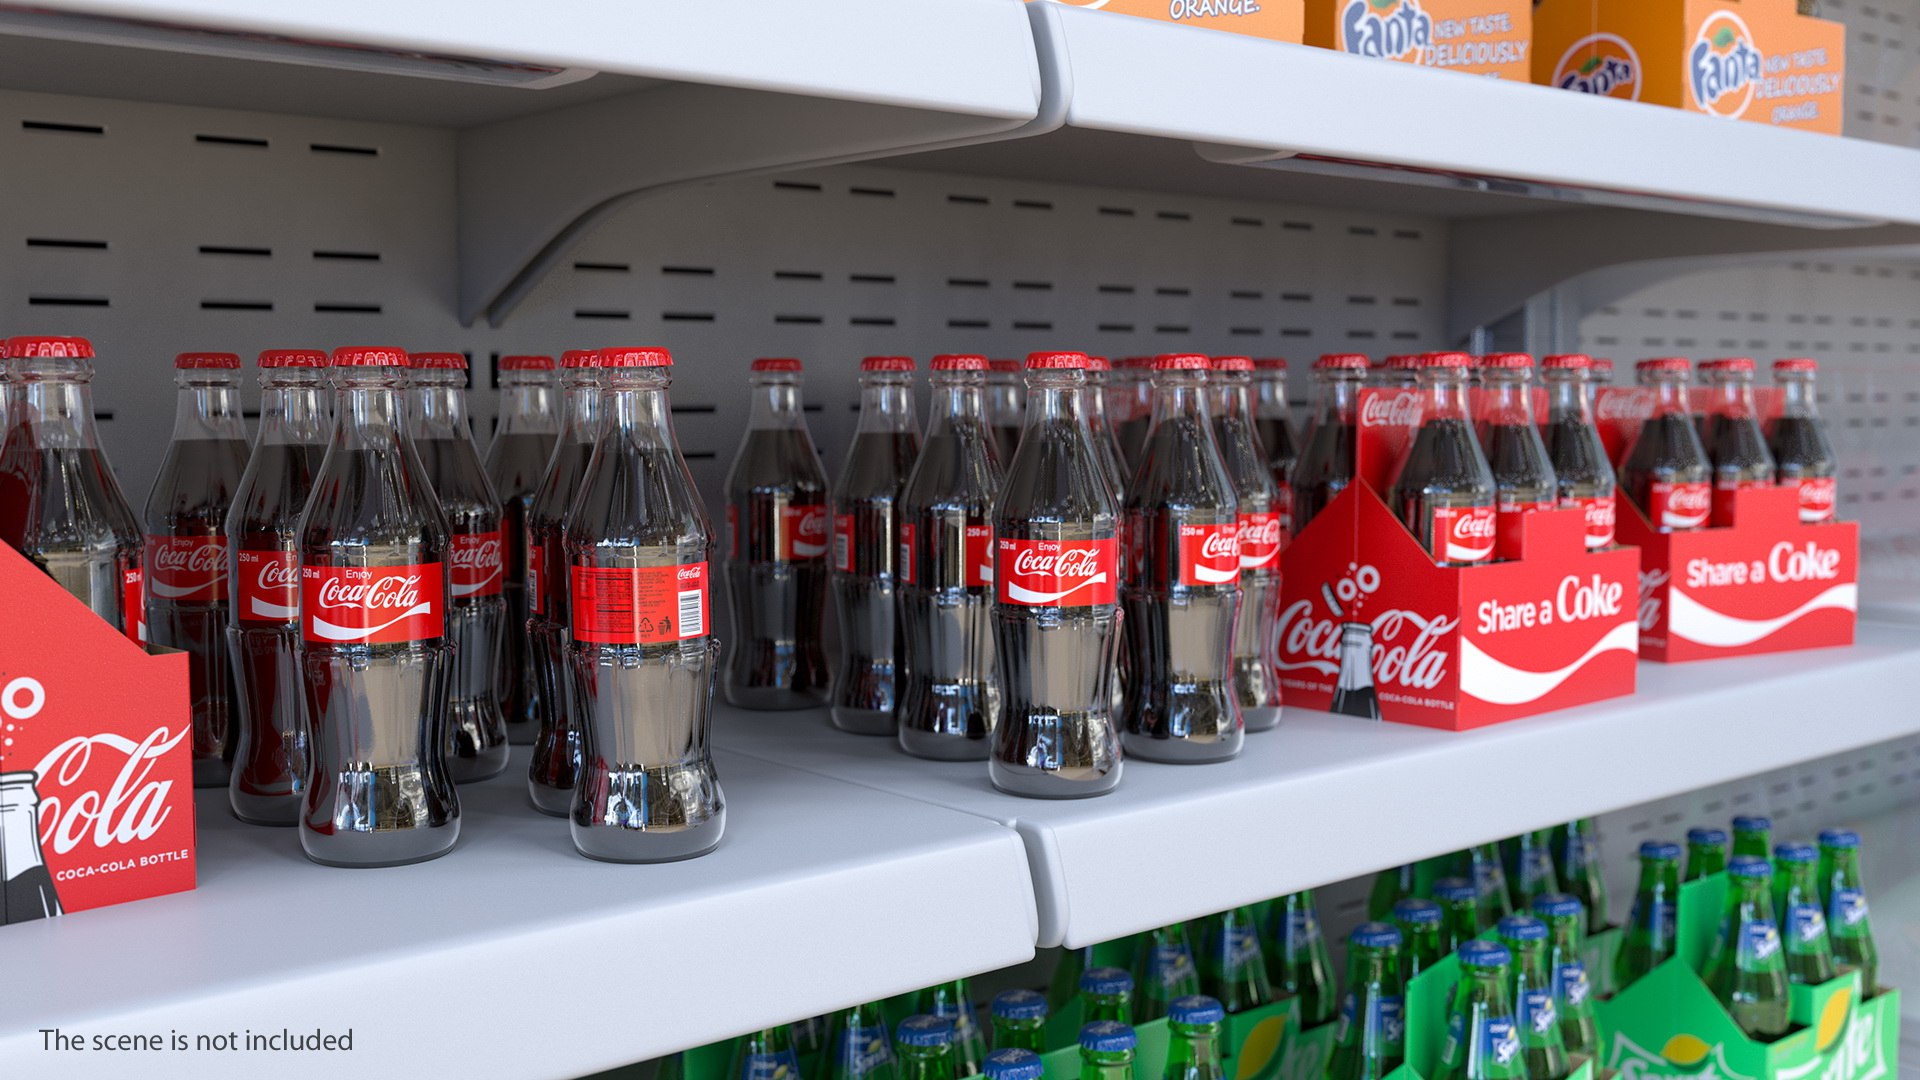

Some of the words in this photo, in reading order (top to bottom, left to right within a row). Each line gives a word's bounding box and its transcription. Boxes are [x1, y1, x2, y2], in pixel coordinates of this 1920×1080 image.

[1434, 20, 1466, 39] NEW
[1469, 13, 1513, 34] TASTE
[1423, 41, 1529, 67] DELICIOUSLY
[1690, 36, 1763, 110] Fanta
[1038, 542, 1061, 552] Enjoy
[303, 567, 313, 578] 250
[345, 569, 373, 579] Enjoy
[1014, 548, 1101, 577] Coca-Cola
[1687, 558, 1747, 588] Share
[1750, 561, 1765, 584] a
[1768, 541, 1841, 582] Coke
[319, 575, 422, 609] Coca-Cola
[1477, 600, 1537, 635] Share
[1539, 600, 1553, 625] a
[1556, 574, 1624, 623] Coke
[56, 857, 137, 882] COCA-COLA
[140, 847, 189, 868] BOTTLE
